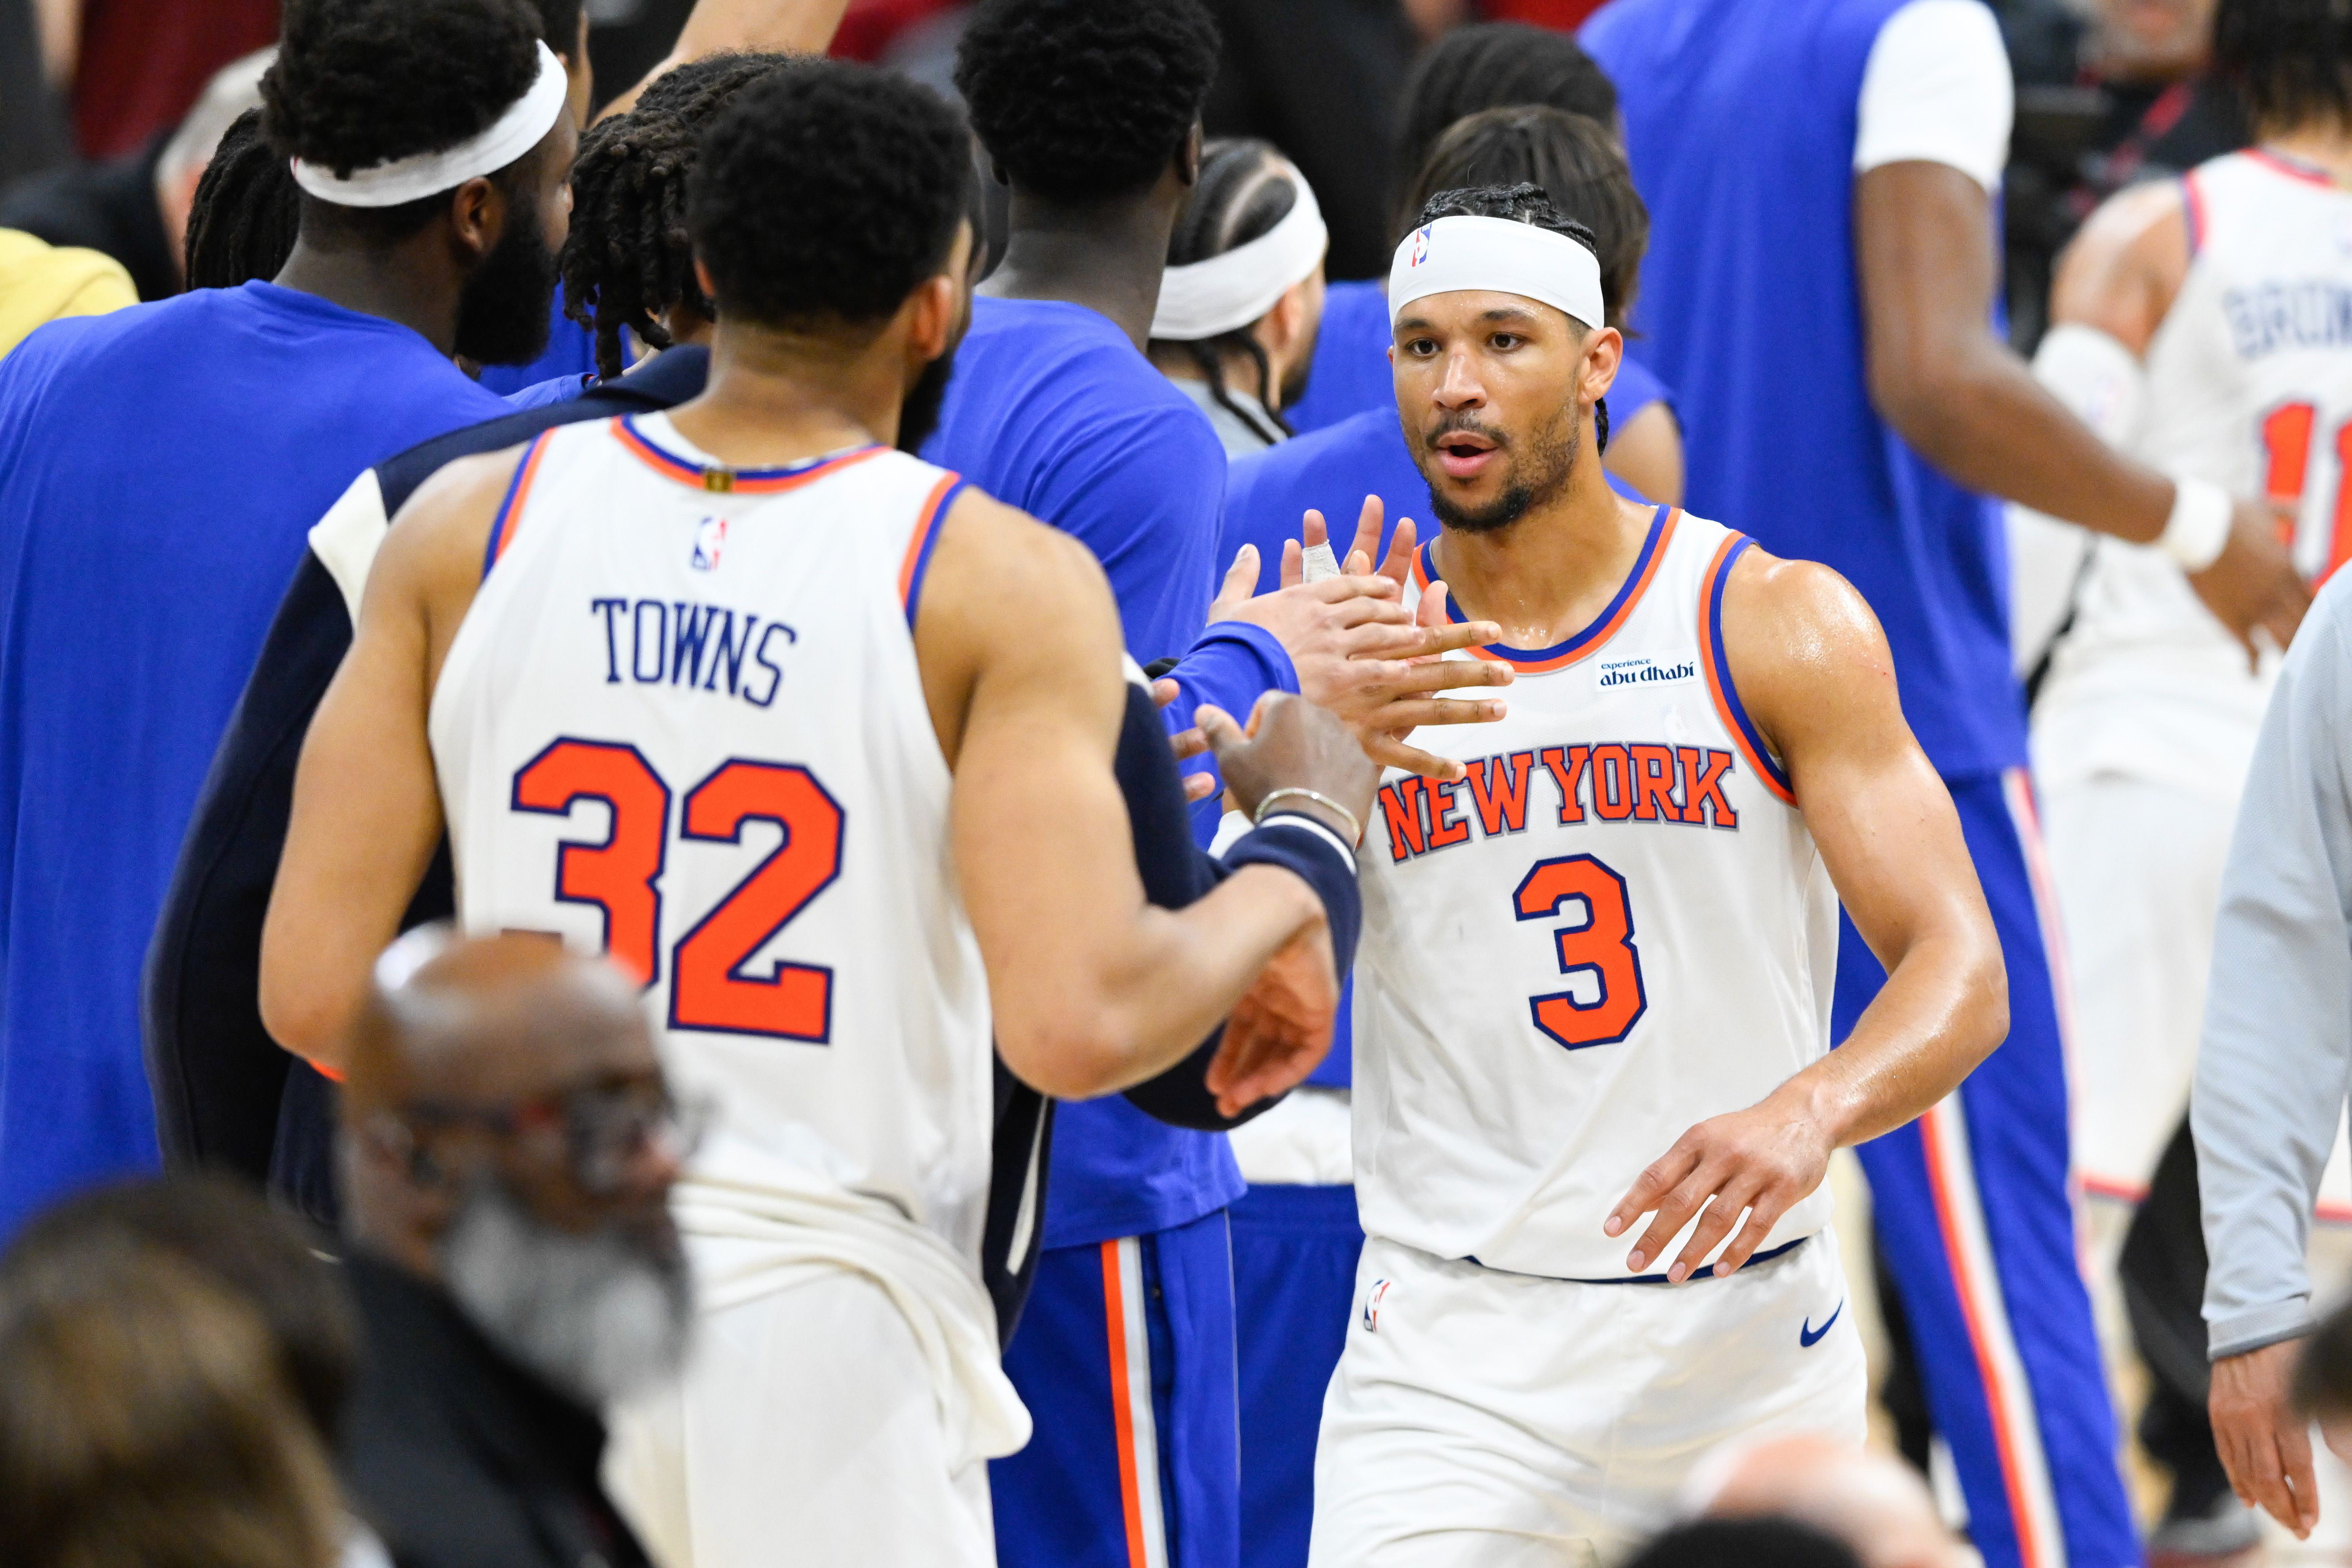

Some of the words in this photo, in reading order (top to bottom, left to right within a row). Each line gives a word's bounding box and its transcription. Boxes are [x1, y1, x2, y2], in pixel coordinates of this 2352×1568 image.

[592, 597, 797, 708] TOWNS
[1600, 671, 1636, 686] abu
[1601, 658, 1651, 670] experience
[1378, 750, 1535, 865] NEW
[1540, 741, 1740, 832] YORK
[510, 735, 845, 1046] 32
[1512, 852, 1647, 1050] 3
